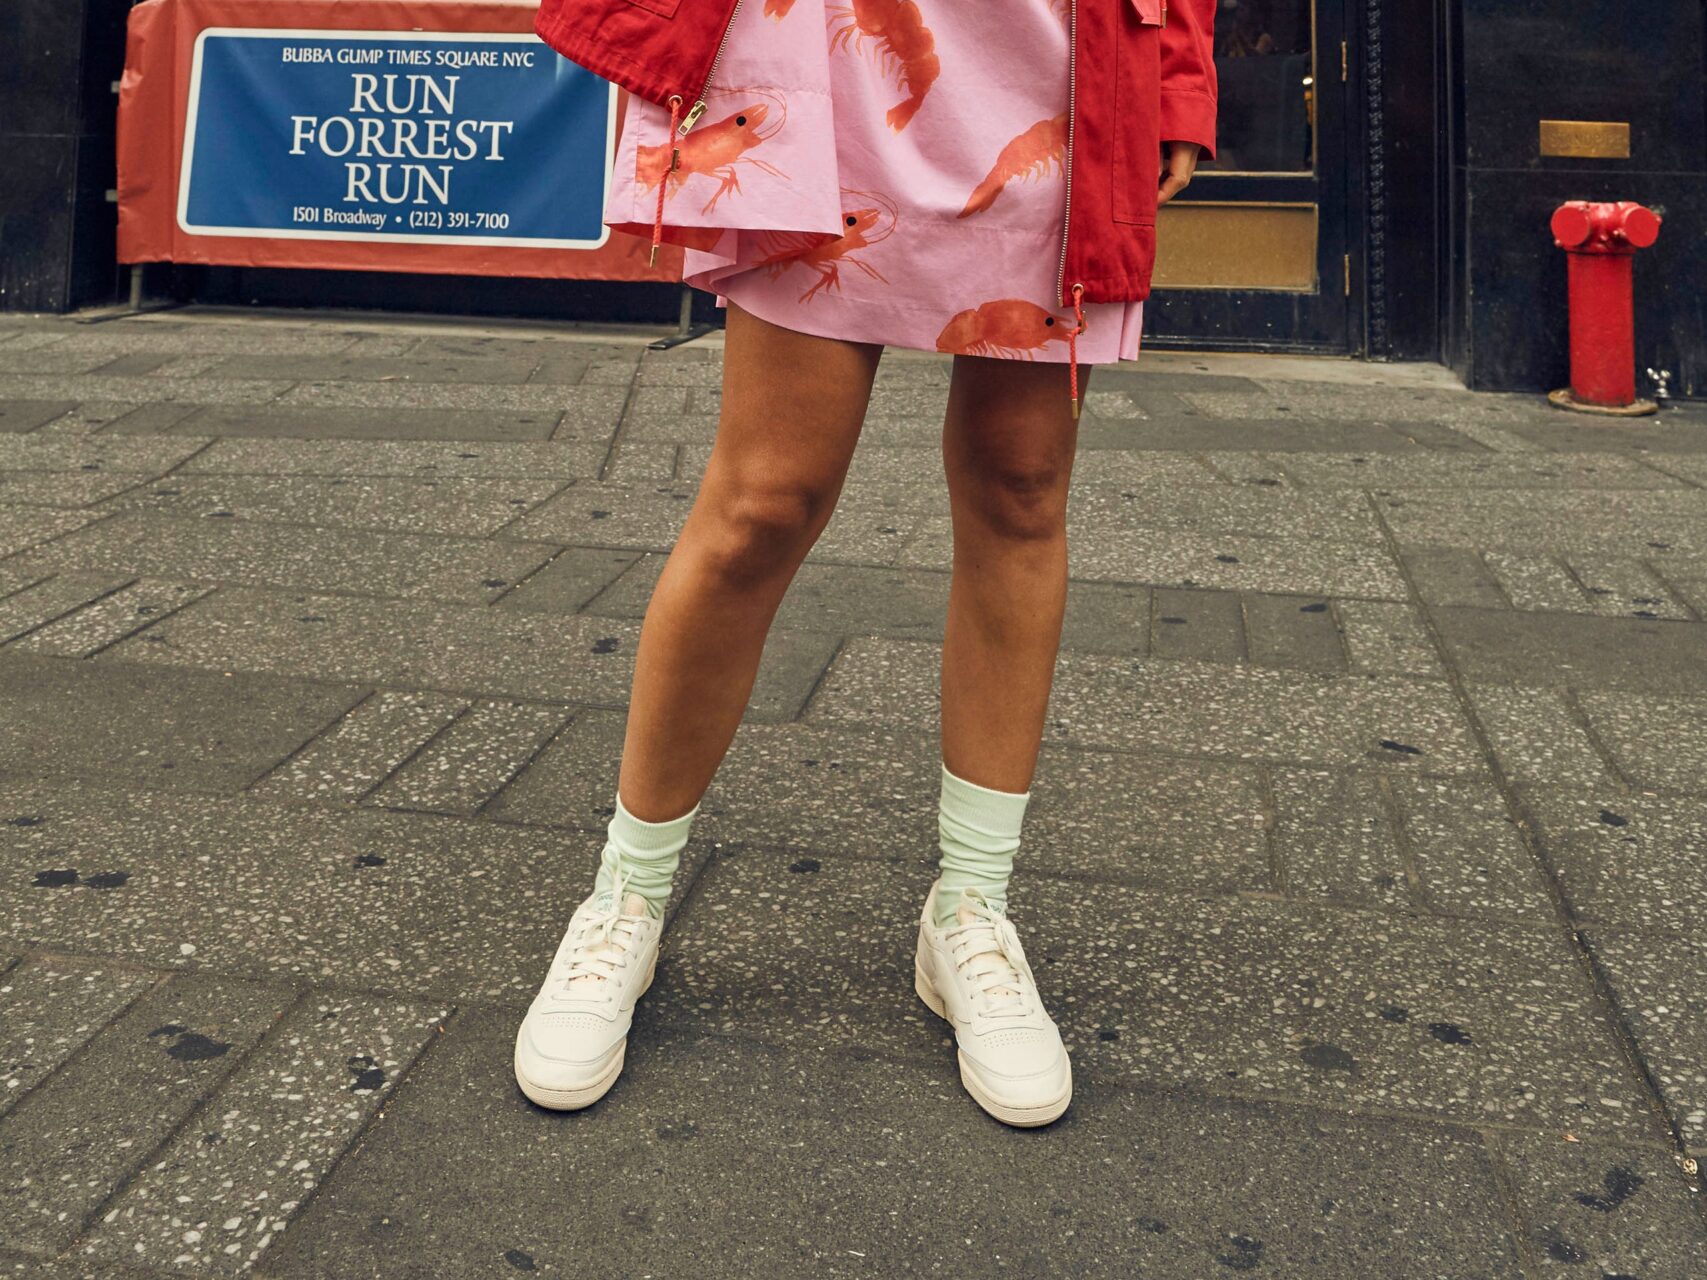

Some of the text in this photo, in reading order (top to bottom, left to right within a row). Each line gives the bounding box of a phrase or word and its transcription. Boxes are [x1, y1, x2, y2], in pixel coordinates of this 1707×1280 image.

[282, 47, 535, 68] BUBBA GUMP TIMES SQUARE NYC
[349, 73, 460, 115] RUN
[289, 116, 513, 161] FORREST
[343, 162, 453, 205] RUN
[293, 206, 509, 230] 1501 Broadway (212) 391-7100
